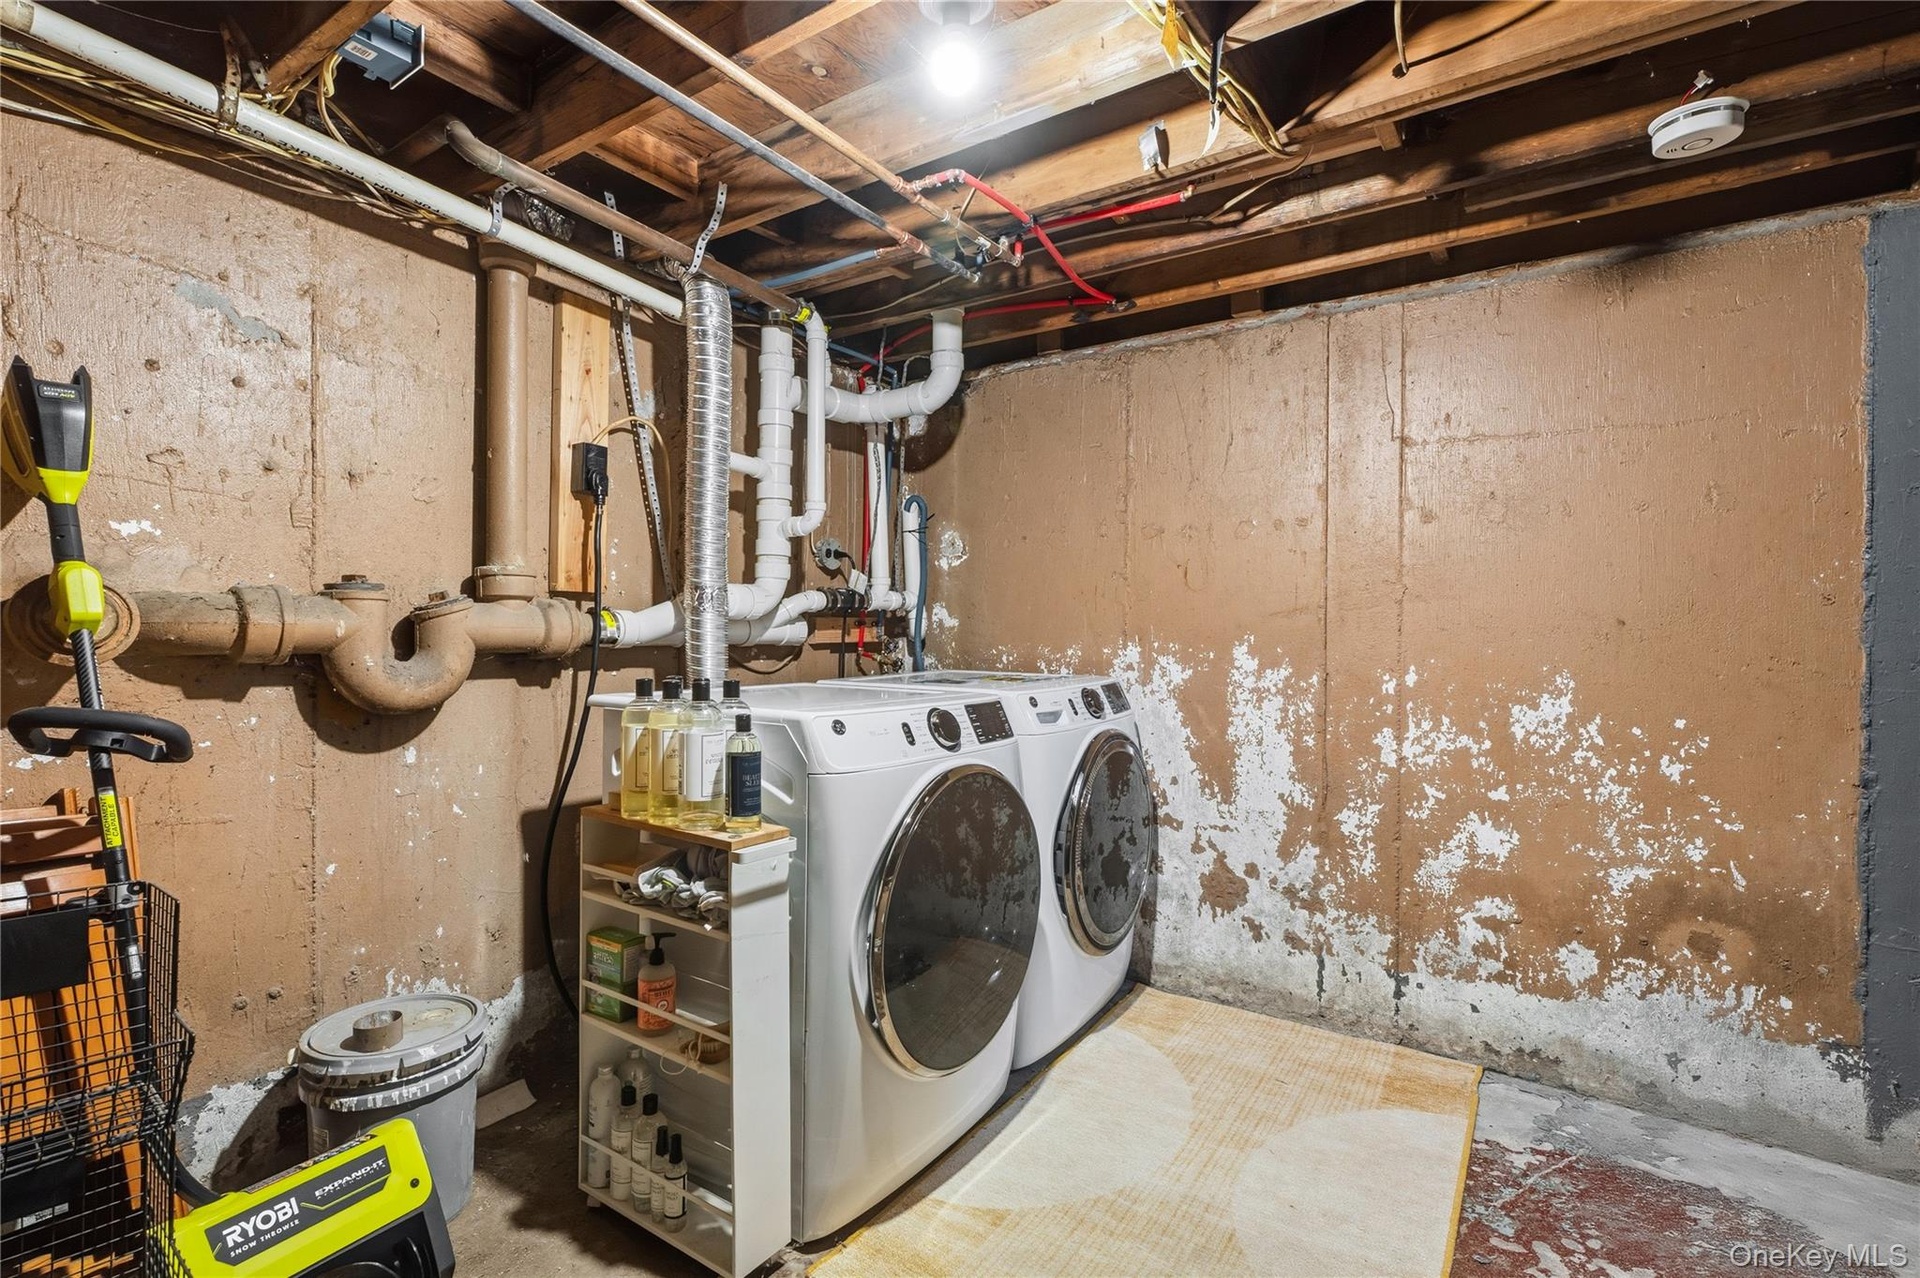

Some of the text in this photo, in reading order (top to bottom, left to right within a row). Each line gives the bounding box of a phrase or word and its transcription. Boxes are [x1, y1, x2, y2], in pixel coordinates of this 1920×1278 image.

[100, 796, 113, 846] ATTACHMENT
[108, 803, 120, 837] CAPABLE
[314, 1157, 386, 1197] EXPAND-IT
[222, 1196, 300, 1248] RYOBI
[230, 1219, 300, 1258] SNOW THROWER
